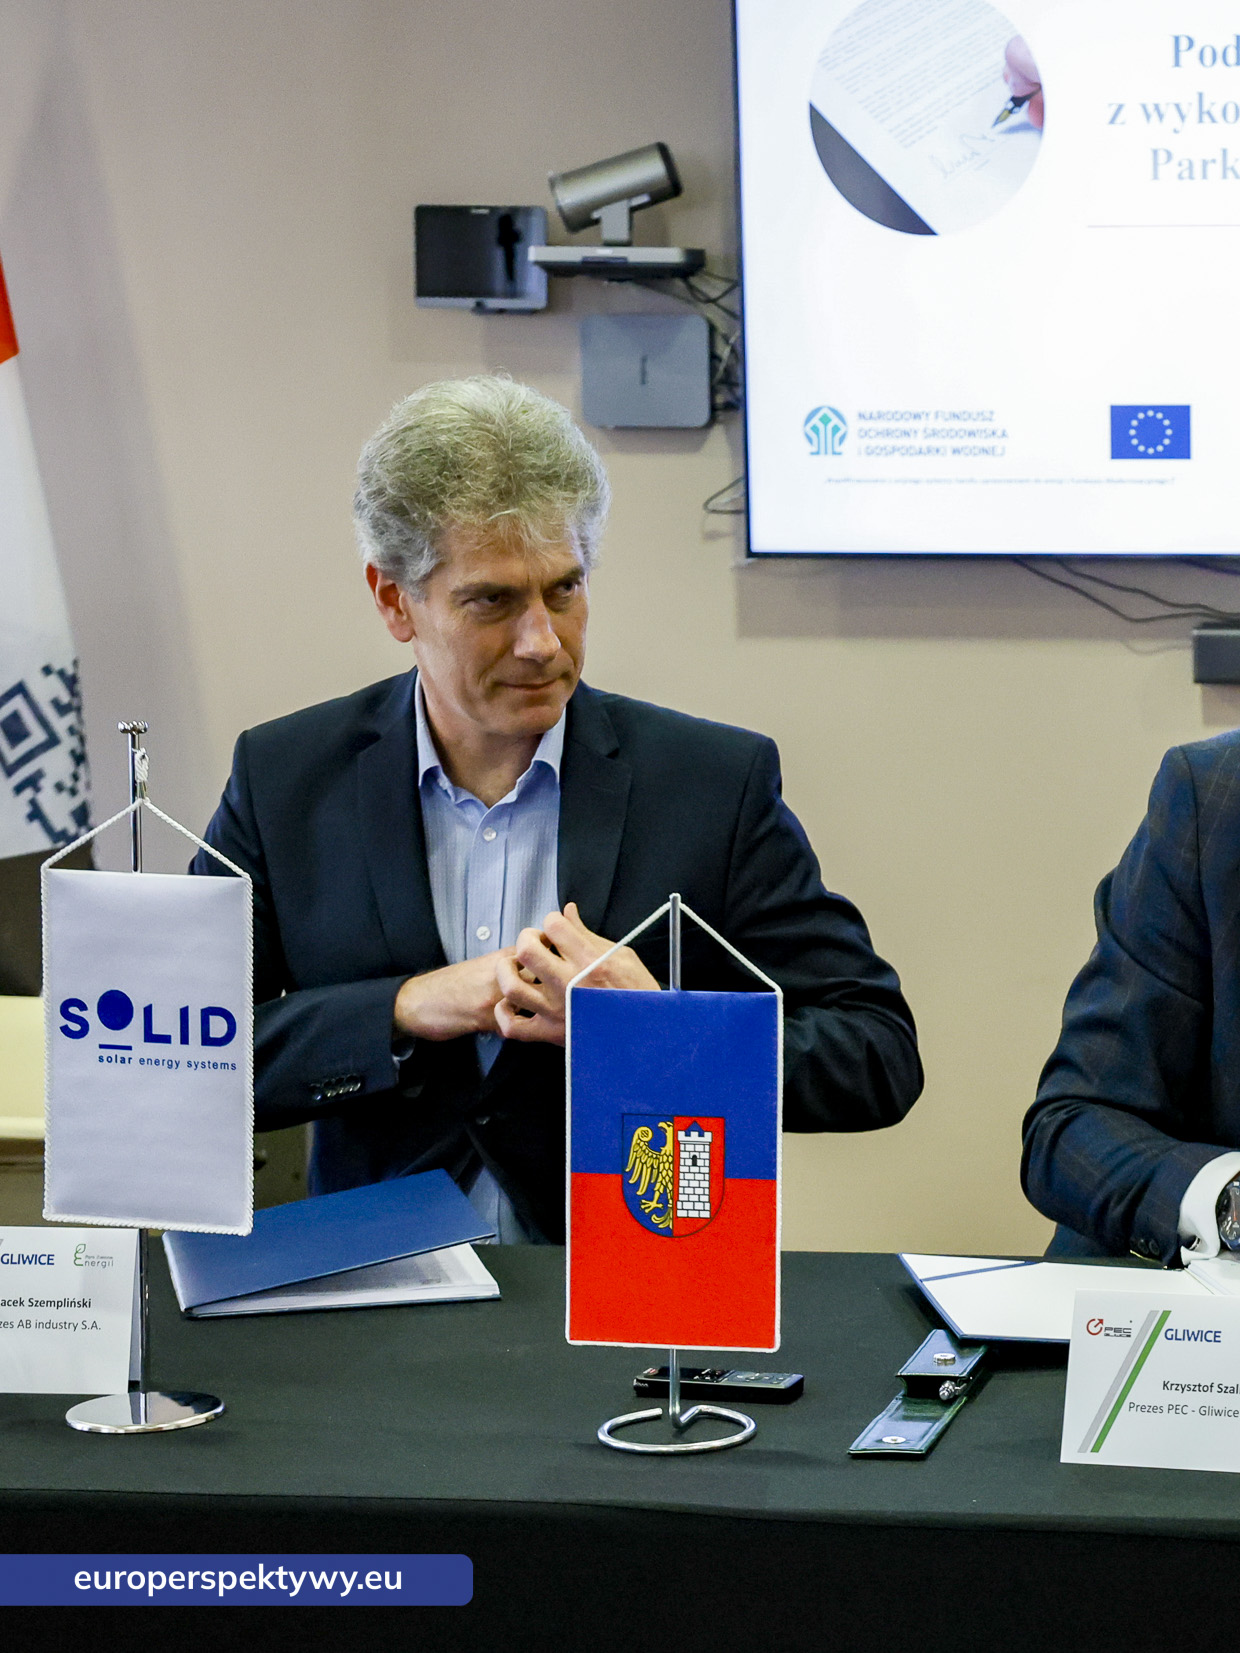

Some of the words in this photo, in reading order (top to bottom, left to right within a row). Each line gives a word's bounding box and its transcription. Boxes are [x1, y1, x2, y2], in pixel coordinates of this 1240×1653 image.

[1108, 103, 1125, 126] z
[58, 989, 237, 1051] SOLID
[98, 1053, 133, 1065] solar
[138, 1057, 181, 1070] energy
[186, 1060, 237, 1071] systems
[0, 1253, 55, 1266] GLIWICE
[27, 1297, 92, 1310] Szempliński
[16, 1319, 32, 1330] AB
[34, 1319, 79, 1333] industry
[81, 1319, 102, 1331] S.A.
[1164, 1327, 1222, 1344] GLIWICE
[1162, 1380, 1215, 1394] Krzysztof
[1128, 1401, 1164, 1414] Prezes
[1167, 1403, 1189, 1416] PEC
[1198, 1405, 1240, 1418] Gliwice
